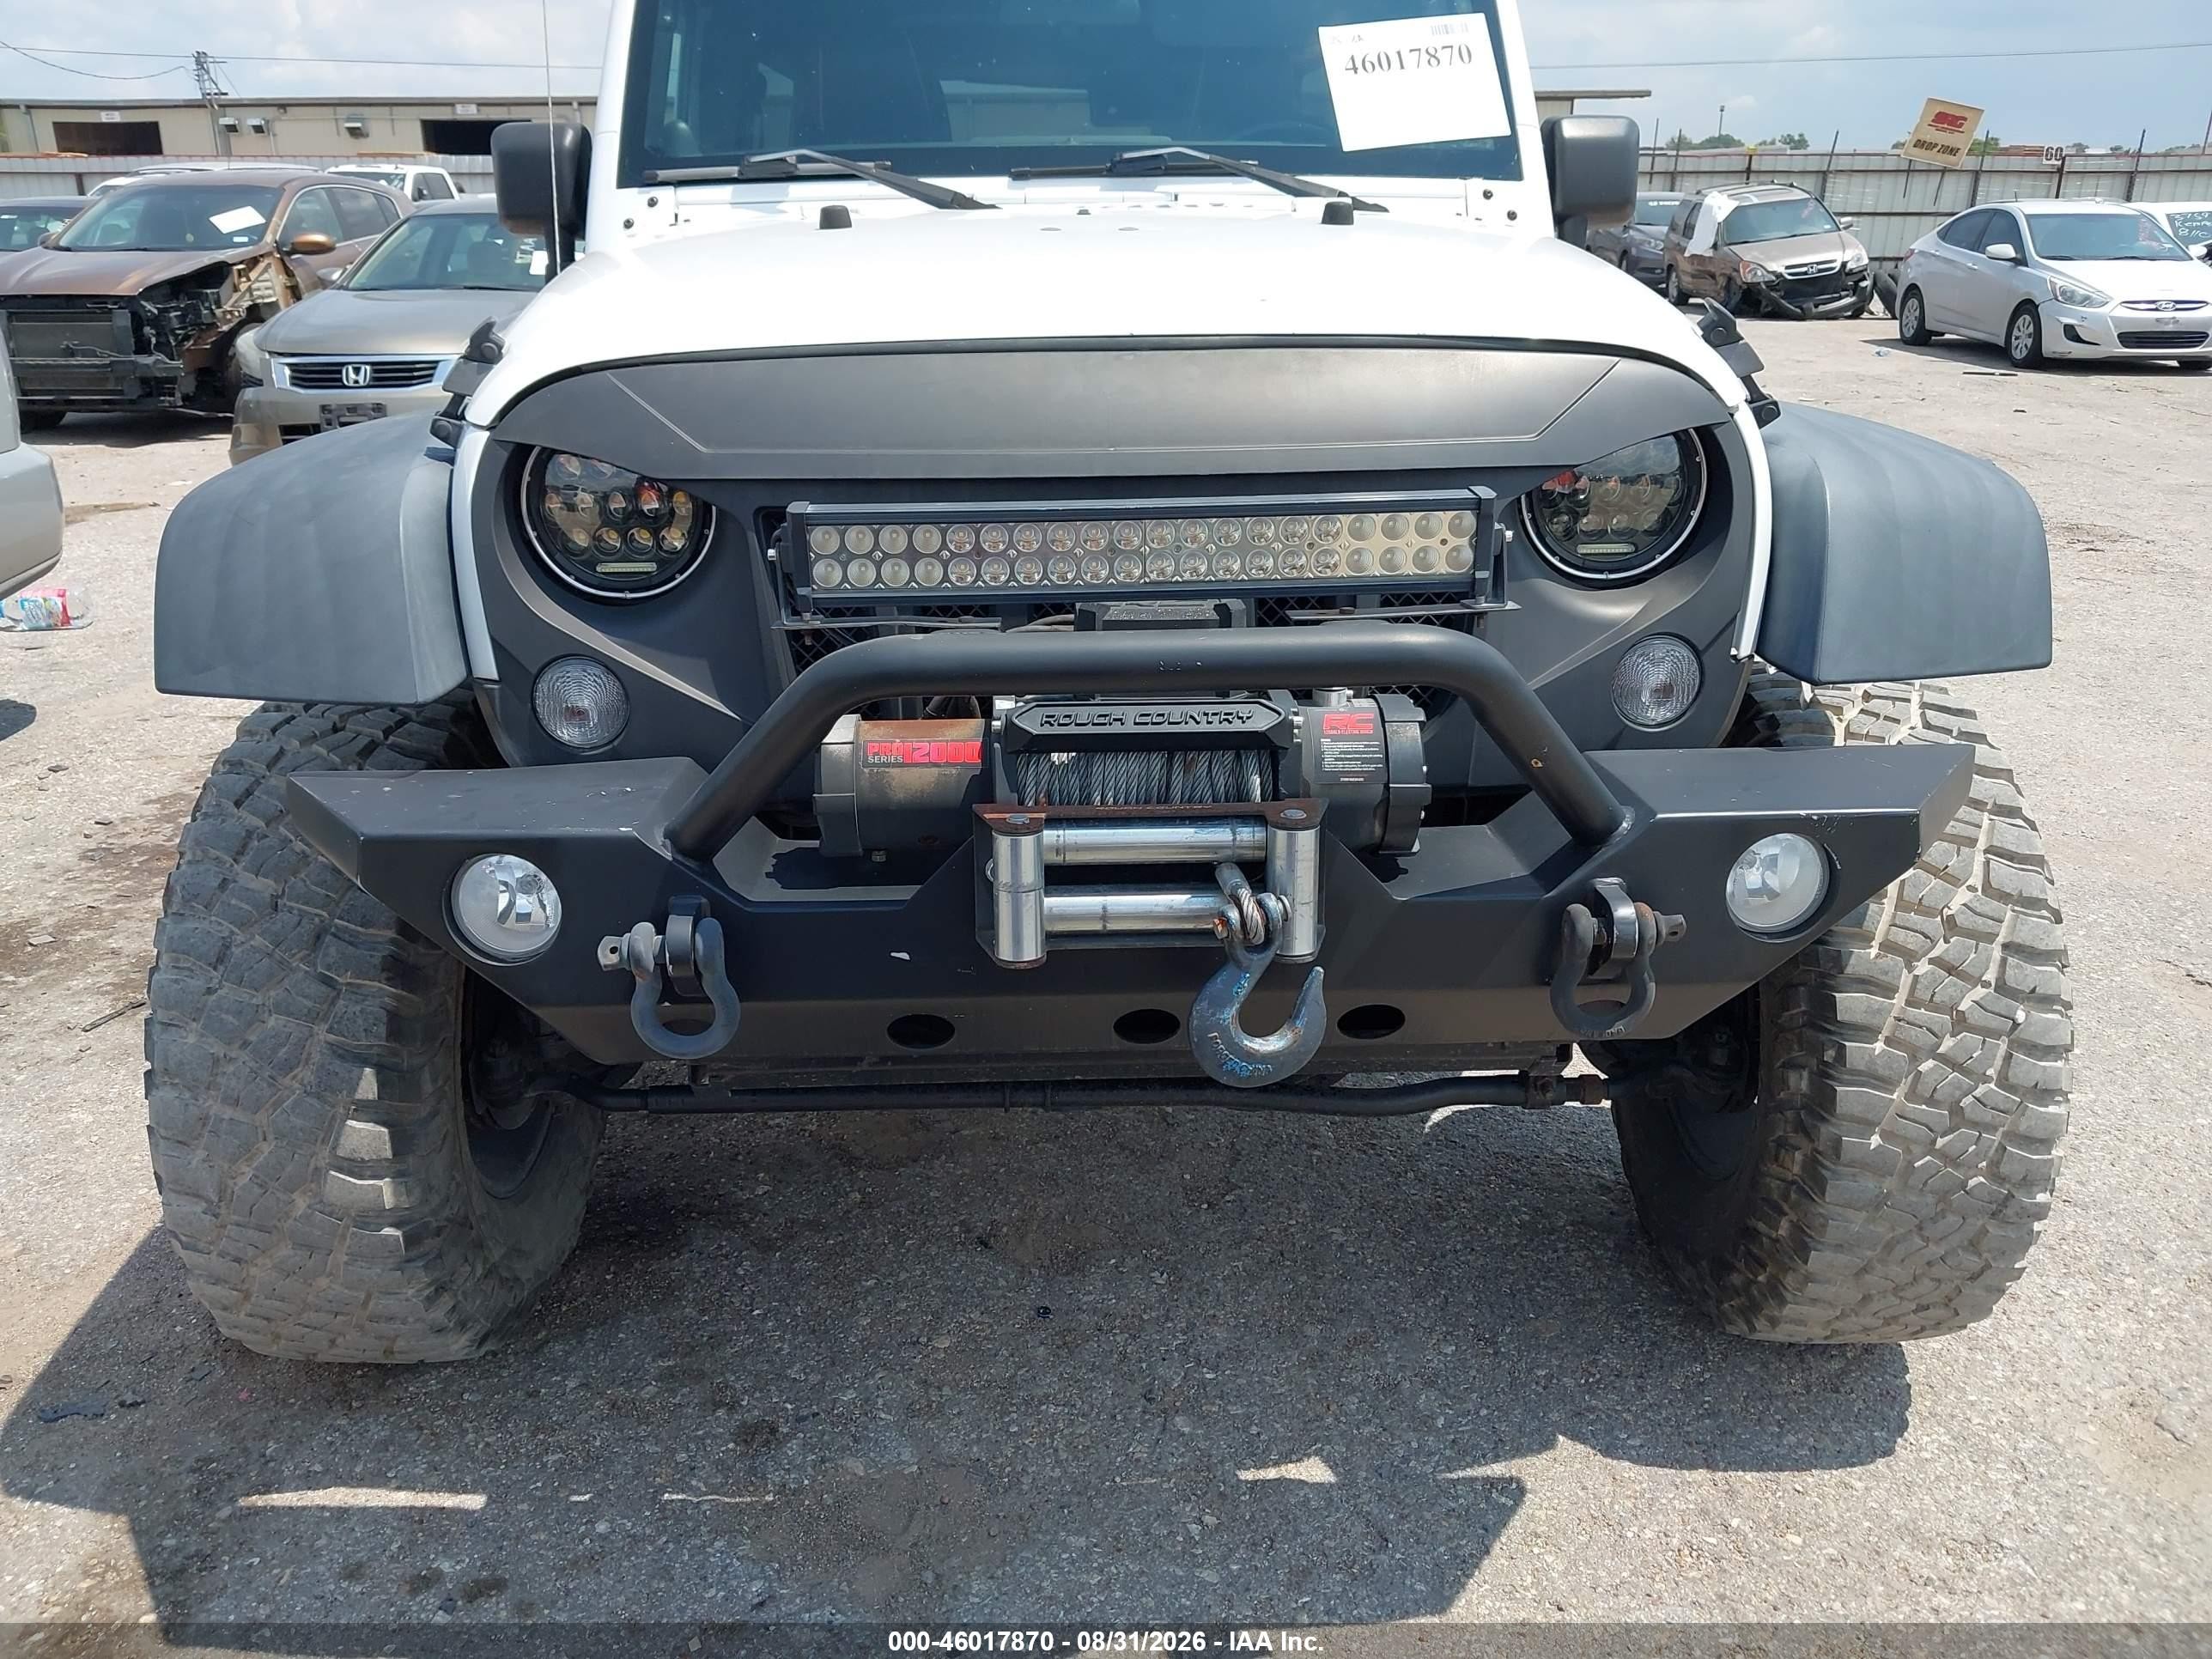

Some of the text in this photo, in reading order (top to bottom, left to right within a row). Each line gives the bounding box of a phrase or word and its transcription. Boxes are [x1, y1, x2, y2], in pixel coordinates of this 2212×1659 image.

[1345, 43, 1473, 76] 46017870
[1913, 138, 1962, 157] DROP ZONE
[2045, 146, 2063, 161] 60
[1040, 708, 1254, 727] ROUGH COUNTRY
[1323, 714, 1375, 730] RC
[867, 741, 981, 763] PRO 12000
